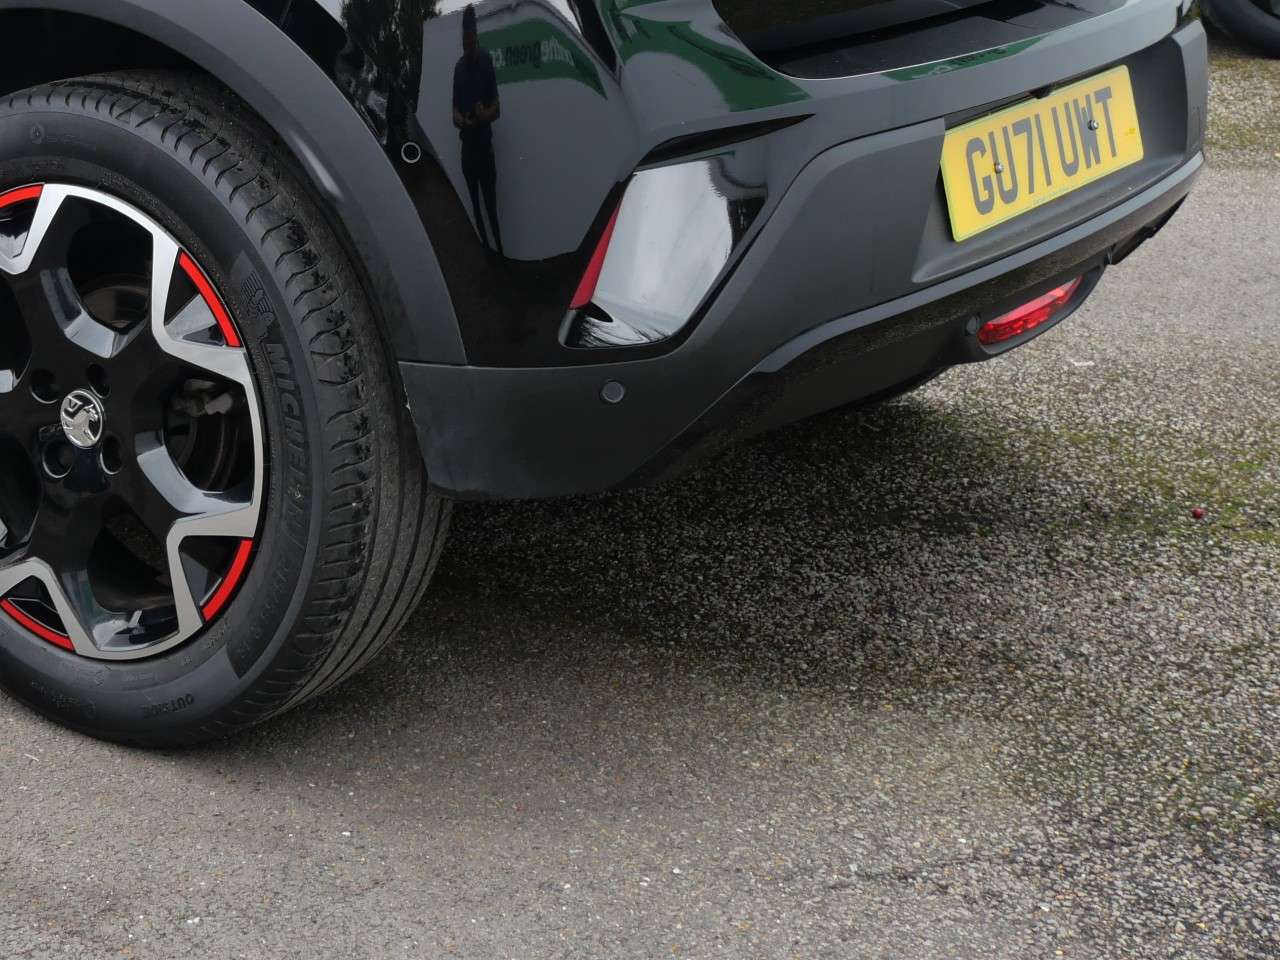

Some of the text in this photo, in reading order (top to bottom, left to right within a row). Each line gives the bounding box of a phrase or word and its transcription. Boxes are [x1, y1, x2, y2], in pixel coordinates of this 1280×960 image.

[965, 86, 1118, 216] GU71 UWT
[266, 341, 309, 530] MICHELIN
